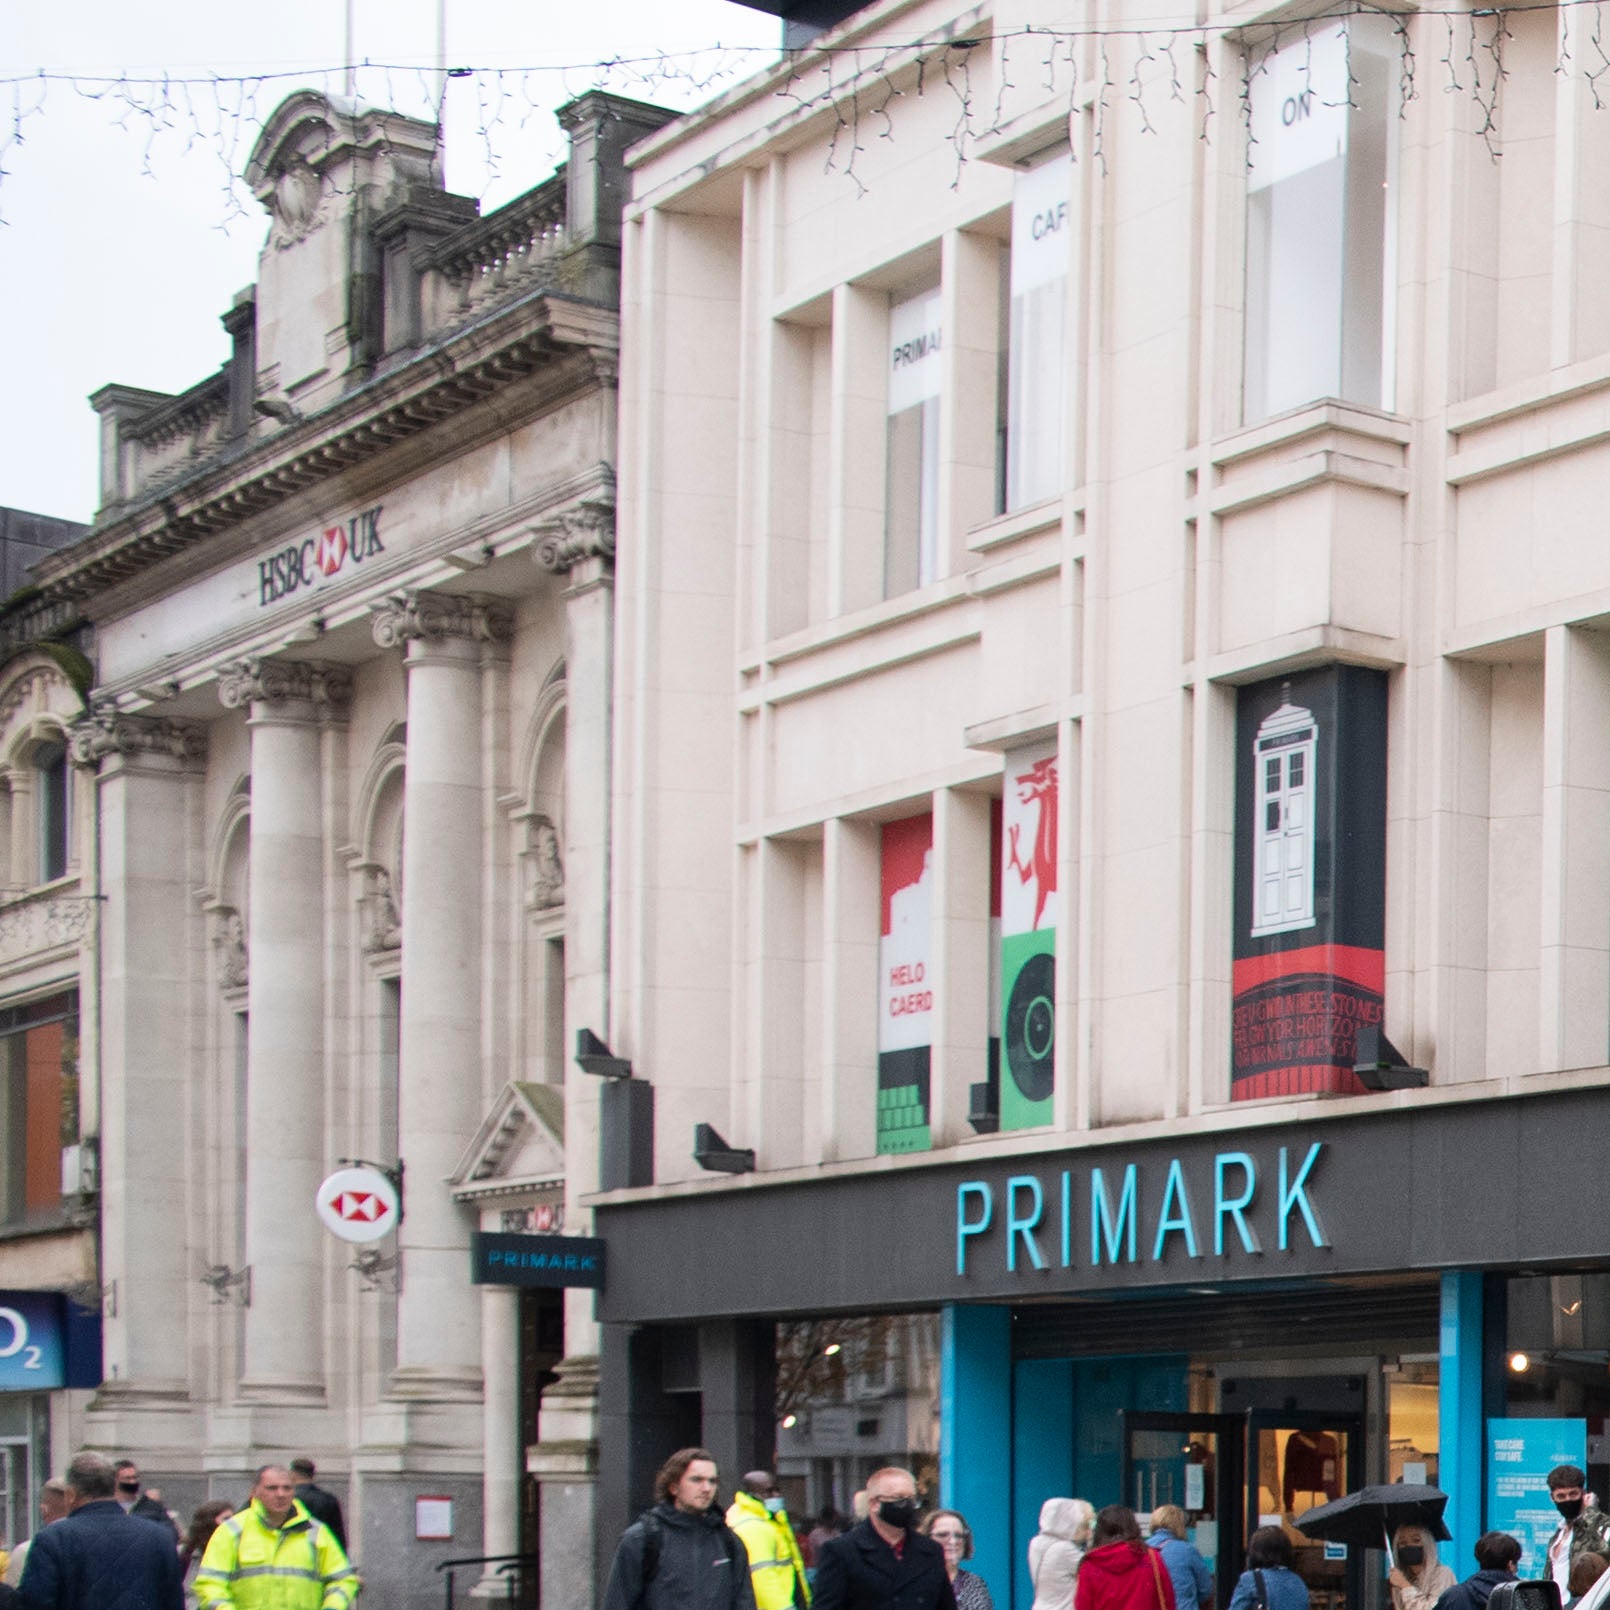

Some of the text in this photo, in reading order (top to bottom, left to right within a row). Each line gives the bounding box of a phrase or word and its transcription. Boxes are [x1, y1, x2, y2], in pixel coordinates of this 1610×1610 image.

[1281, 94, 1311, 126] ON
[1032, 202, 1070, 241] CAF
[893, 327, 941, 370] PRIMA
[258, 505, 384, 606] HSBC UK
[890, 962, 924, 987] HELO
[956, 1142, 1329, 1275] PRIMARK
[488, 1249, 596, 1271] PRIMARK
